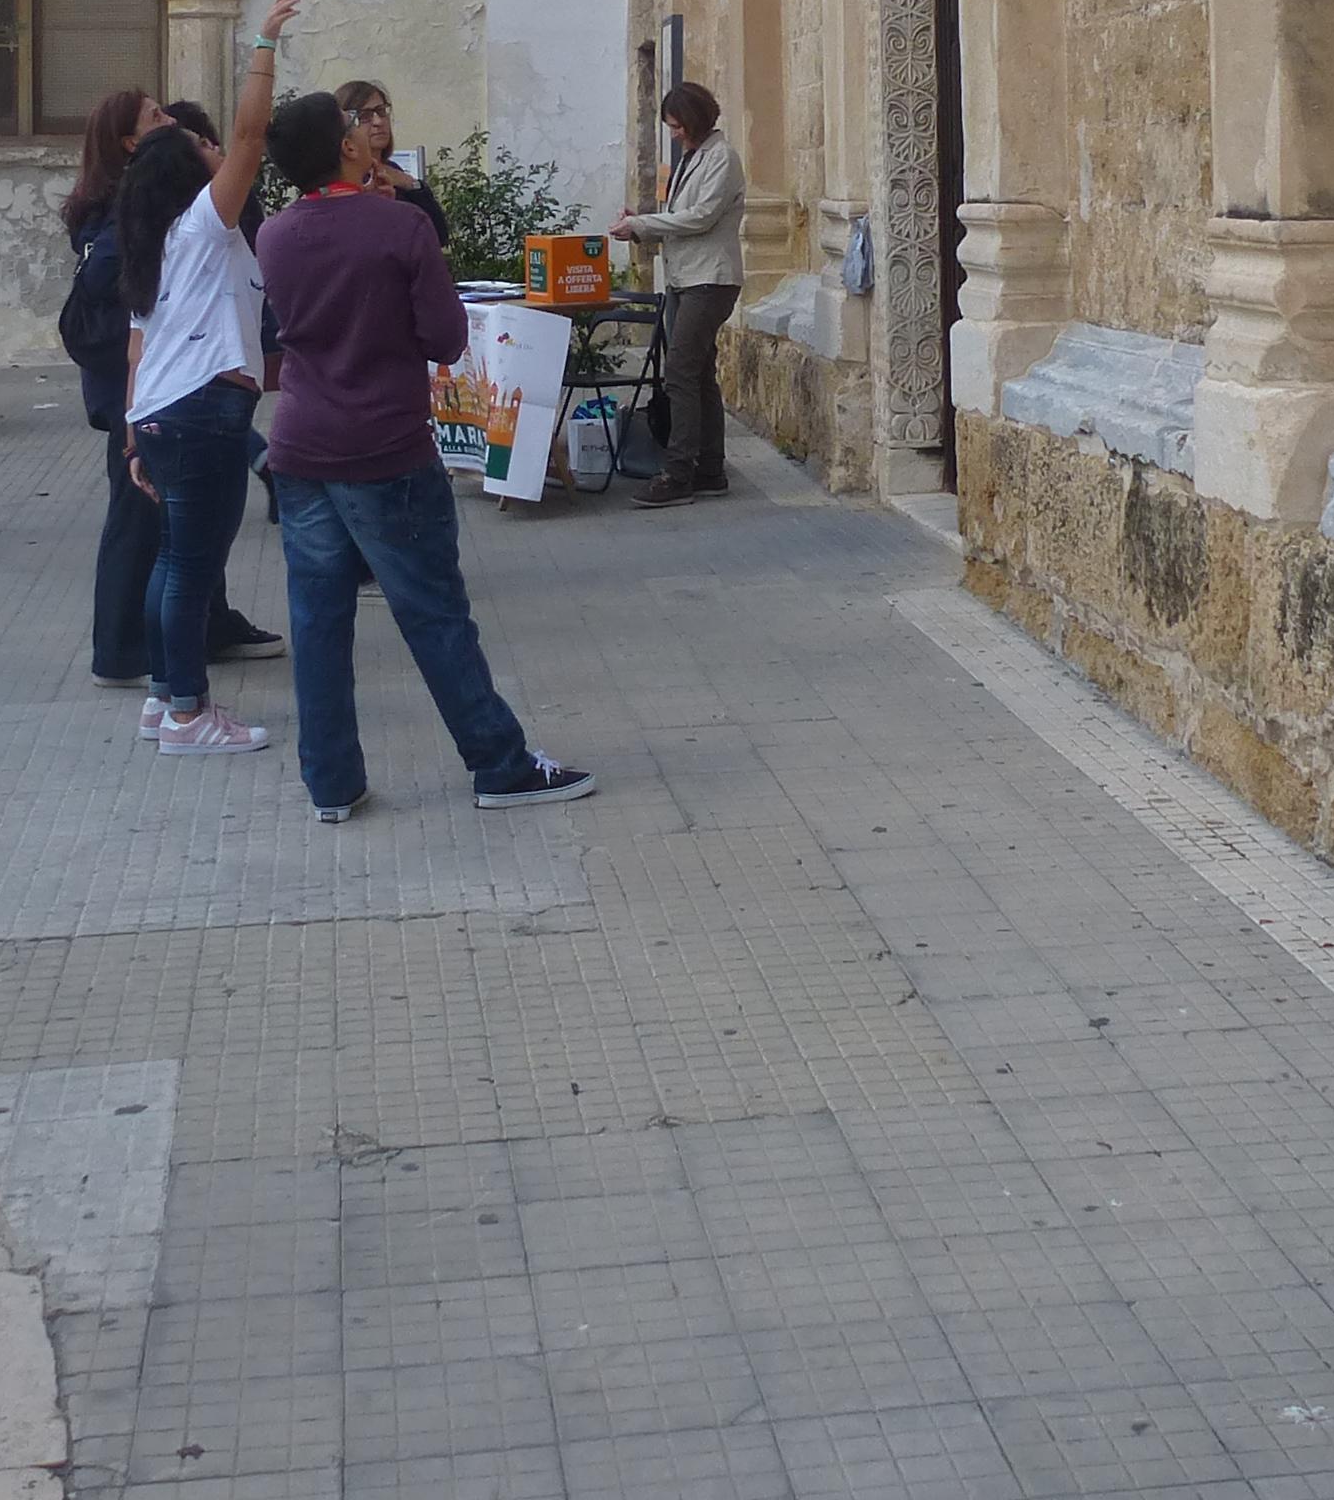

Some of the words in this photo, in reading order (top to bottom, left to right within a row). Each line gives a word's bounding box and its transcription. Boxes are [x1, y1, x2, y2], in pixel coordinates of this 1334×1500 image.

[566, 264, 594, 274] VISITA
[557, 275, 565, 285] A
[565, 274, 603, 284] OFFERTA
[565, 284, 596, 294] LIBERA
